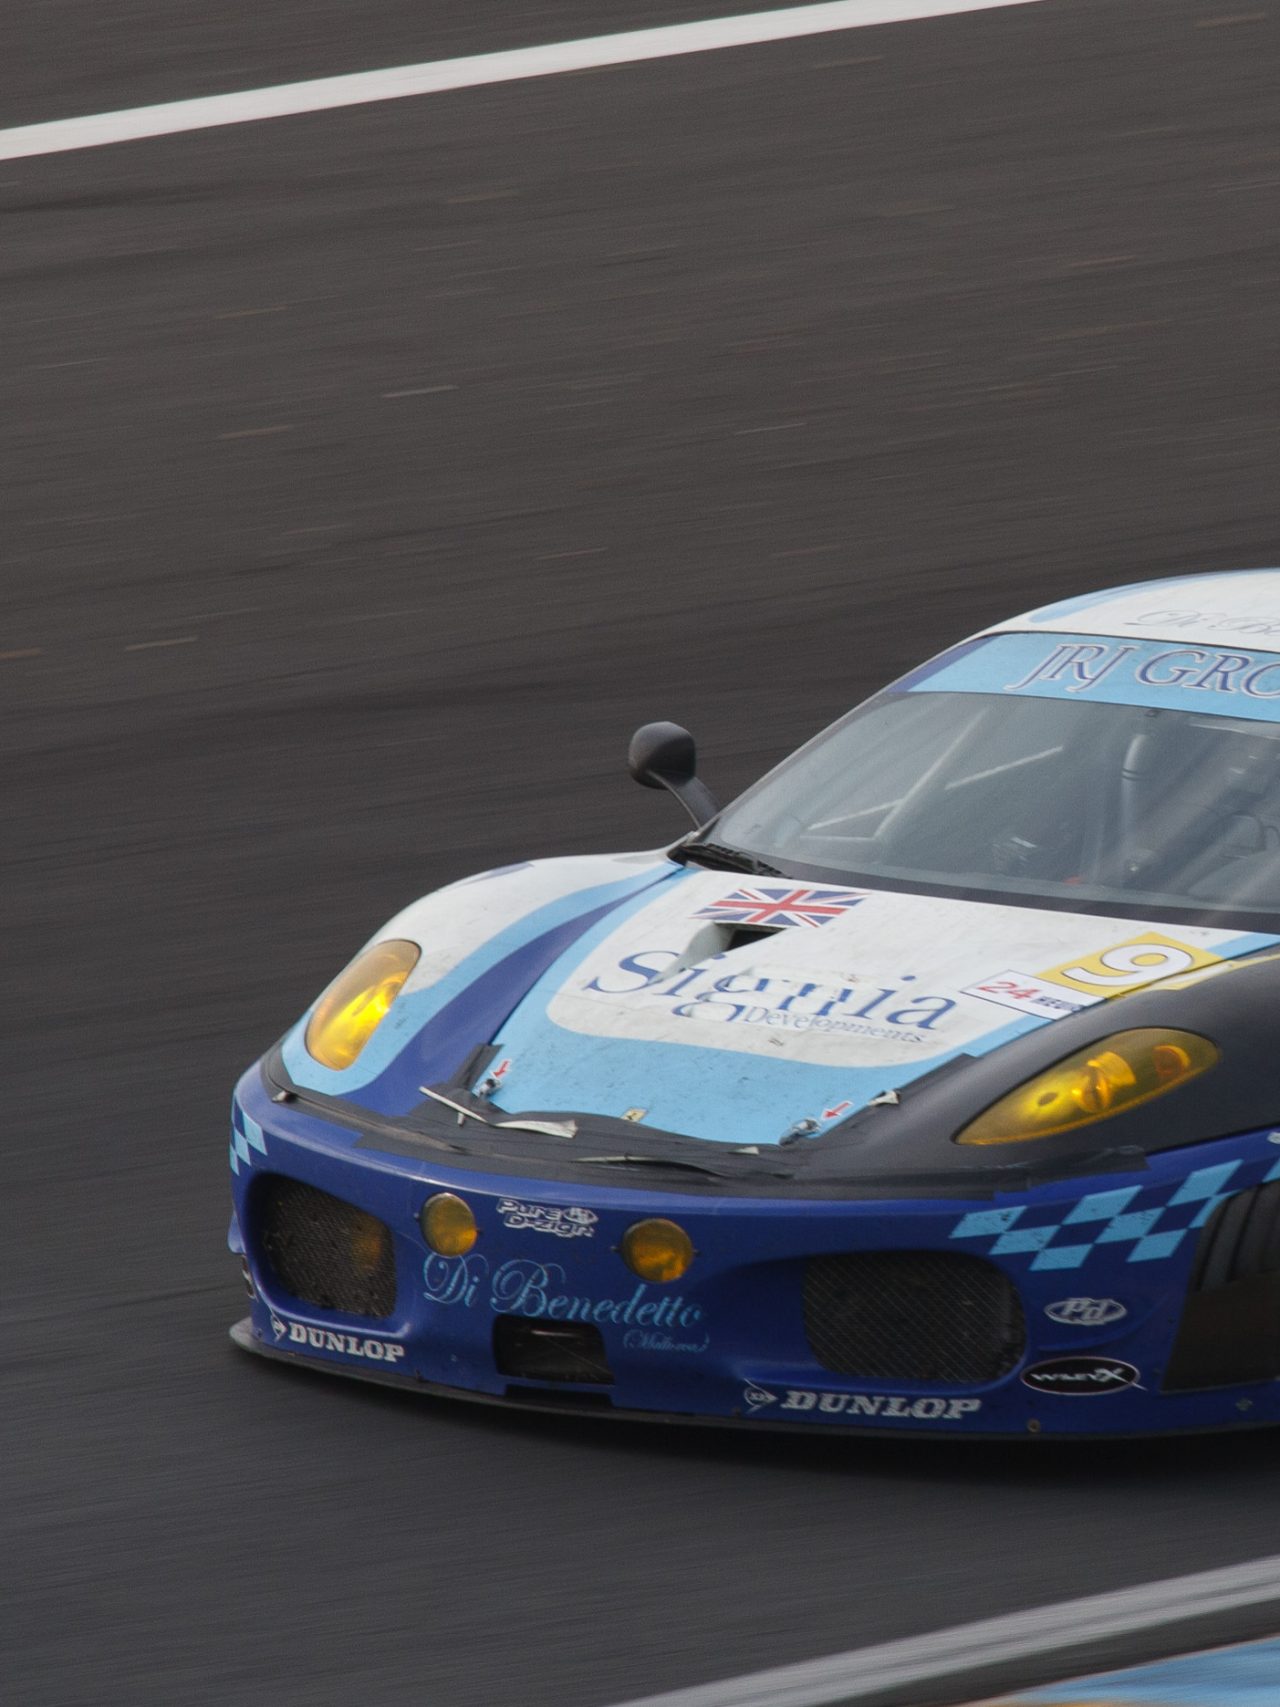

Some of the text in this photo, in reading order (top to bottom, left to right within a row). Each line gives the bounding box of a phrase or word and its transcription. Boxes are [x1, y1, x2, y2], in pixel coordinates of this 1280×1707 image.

[976, 981, 1040, 999] 24
[744, 1006, 926, 1043] Developments
[423, 1252, 702, 1327] Di Benedetto
[288, 1321, 405, 1363] DUNLOP
[780, 1390, 982, 1419] DUNLOP
